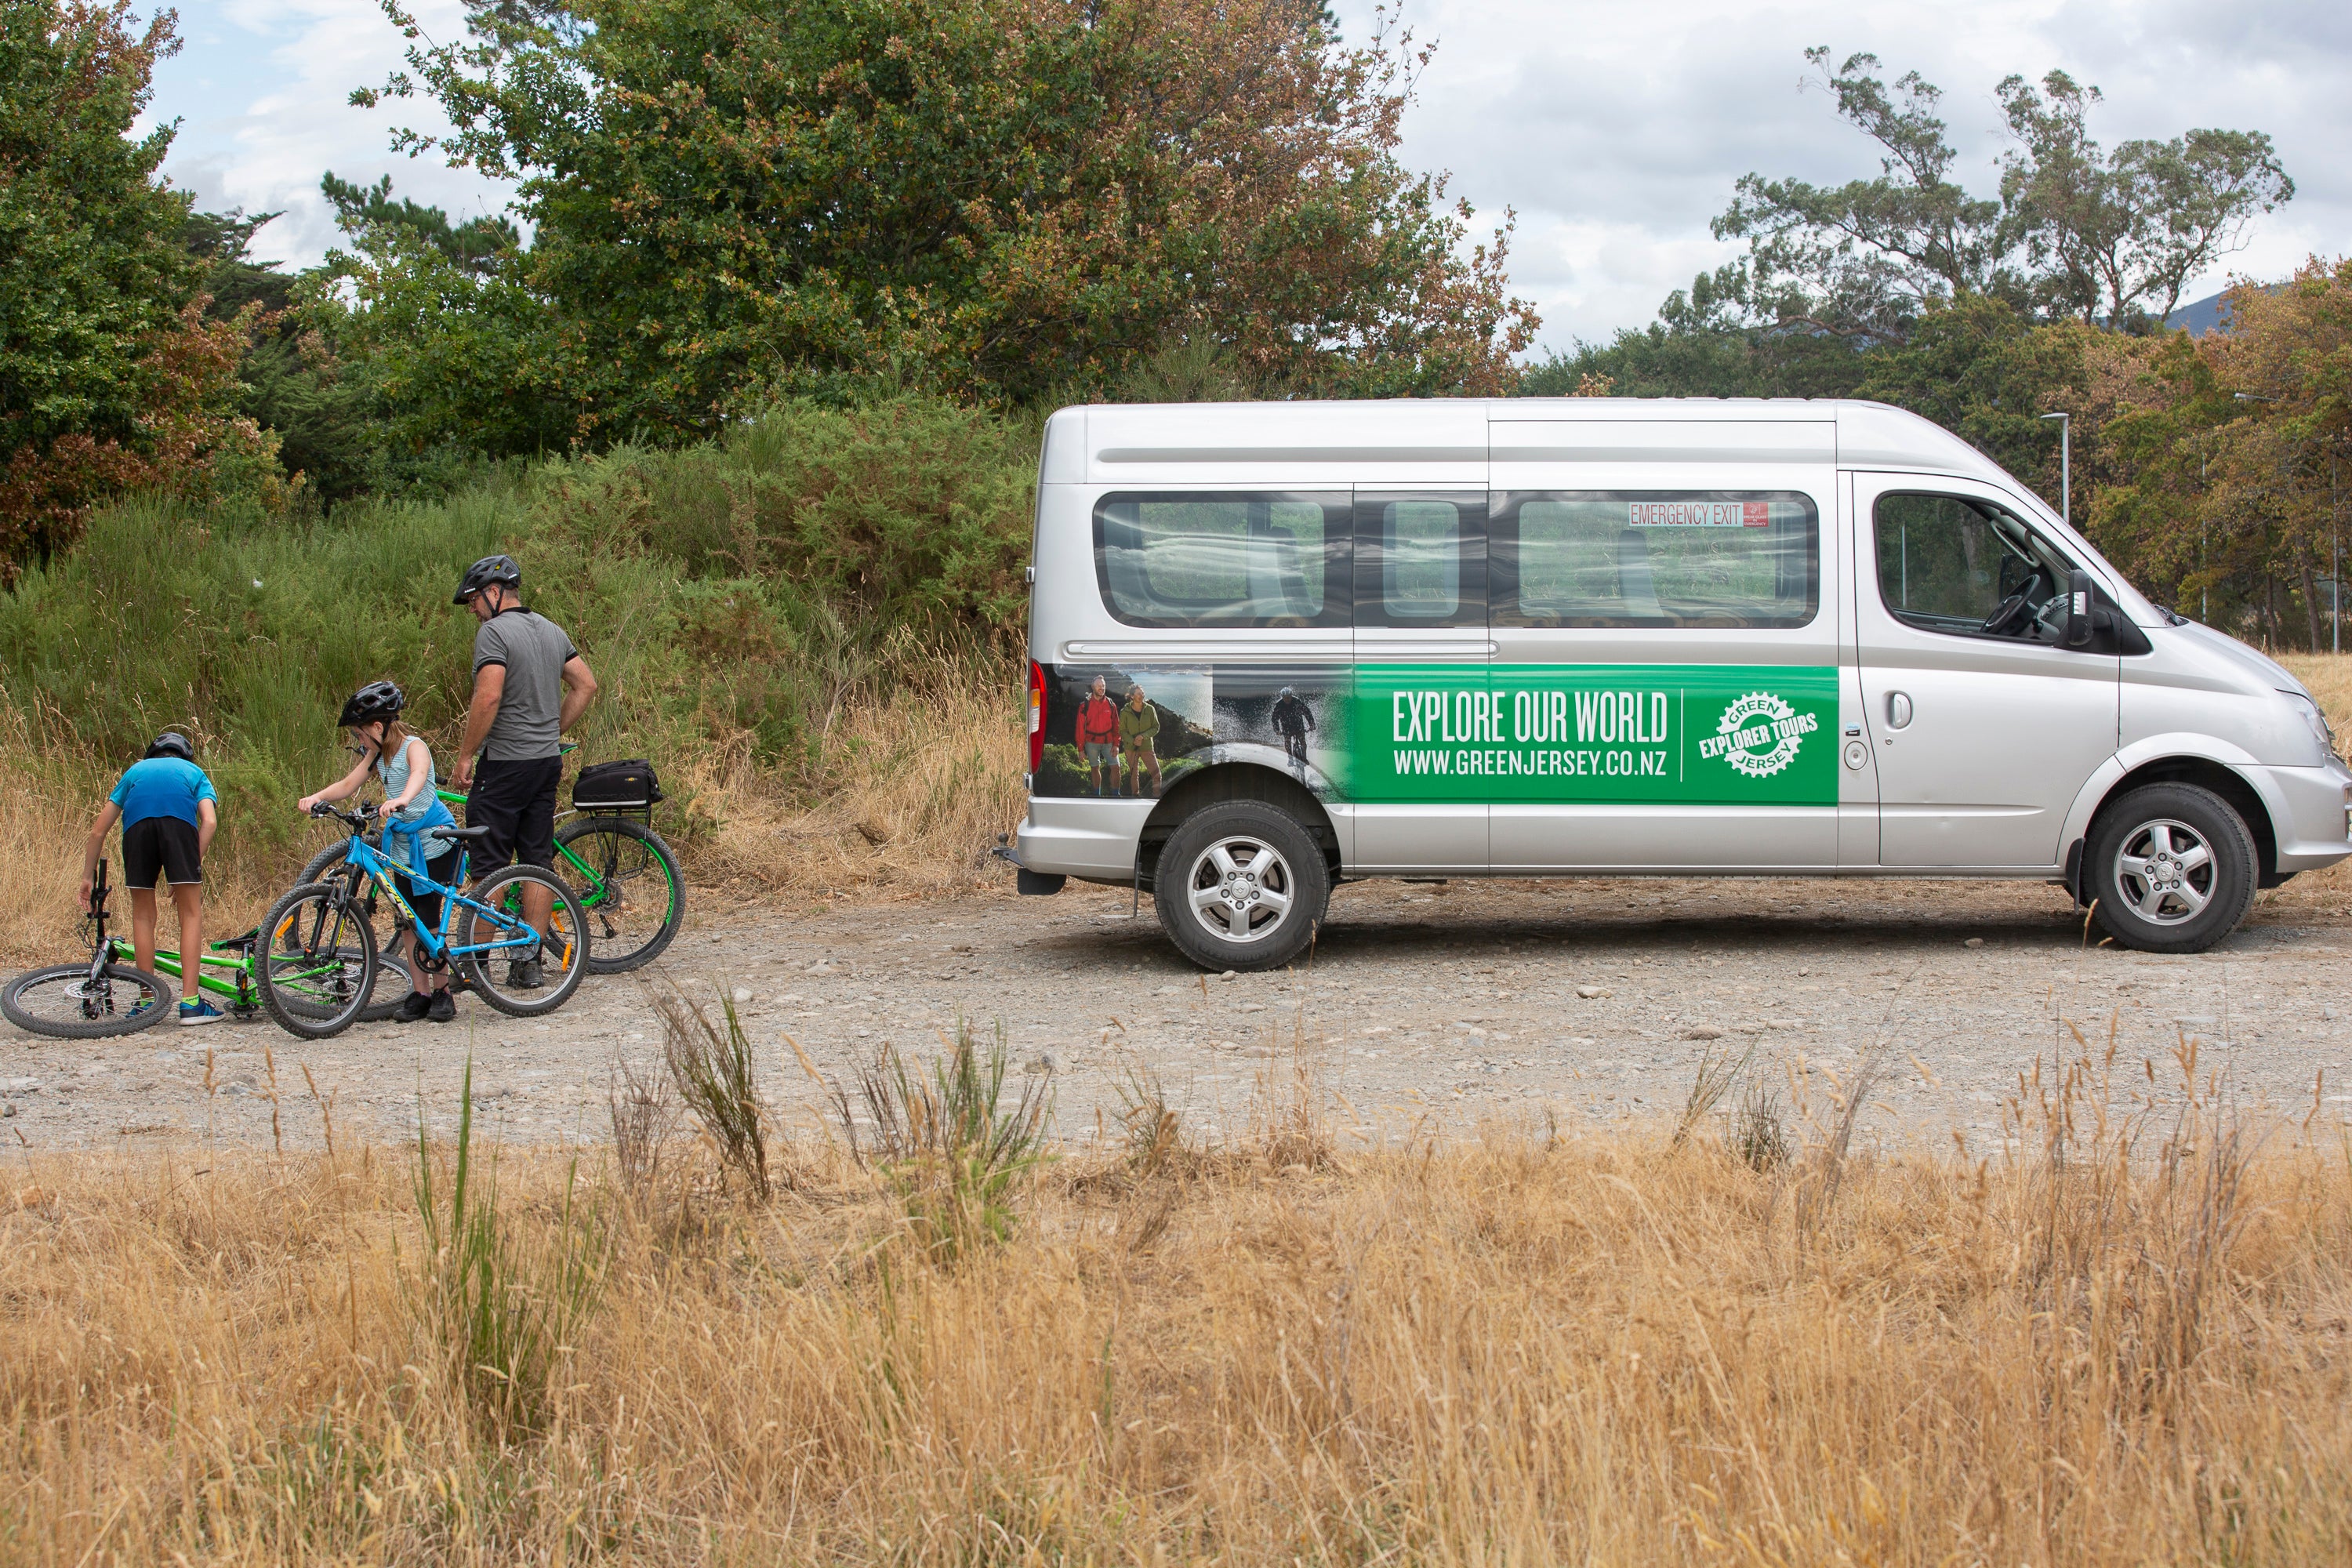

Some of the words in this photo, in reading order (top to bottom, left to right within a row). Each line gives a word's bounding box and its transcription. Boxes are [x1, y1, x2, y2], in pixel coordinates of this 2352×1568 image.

[1631, 504, 1709, 524] EMERGENCY
[1713, 504, 1740, 524] EXIT
[1392, 691, 1506, 742] EXPLORE
[1514, 691, 1568, 742] OUR
[1574, 691, 1668, 743] WORLD
[1728, 699, 1780, 724] GREEN
[1698, 724, 1772, 760] EXPLORER
[1769, 712, 1819, 741] TOURS
[1393, 750, 1668, 776] WWW.GREENJERSEY.CO.NZ
[1735, 740, 1793, 769] JERSEY
